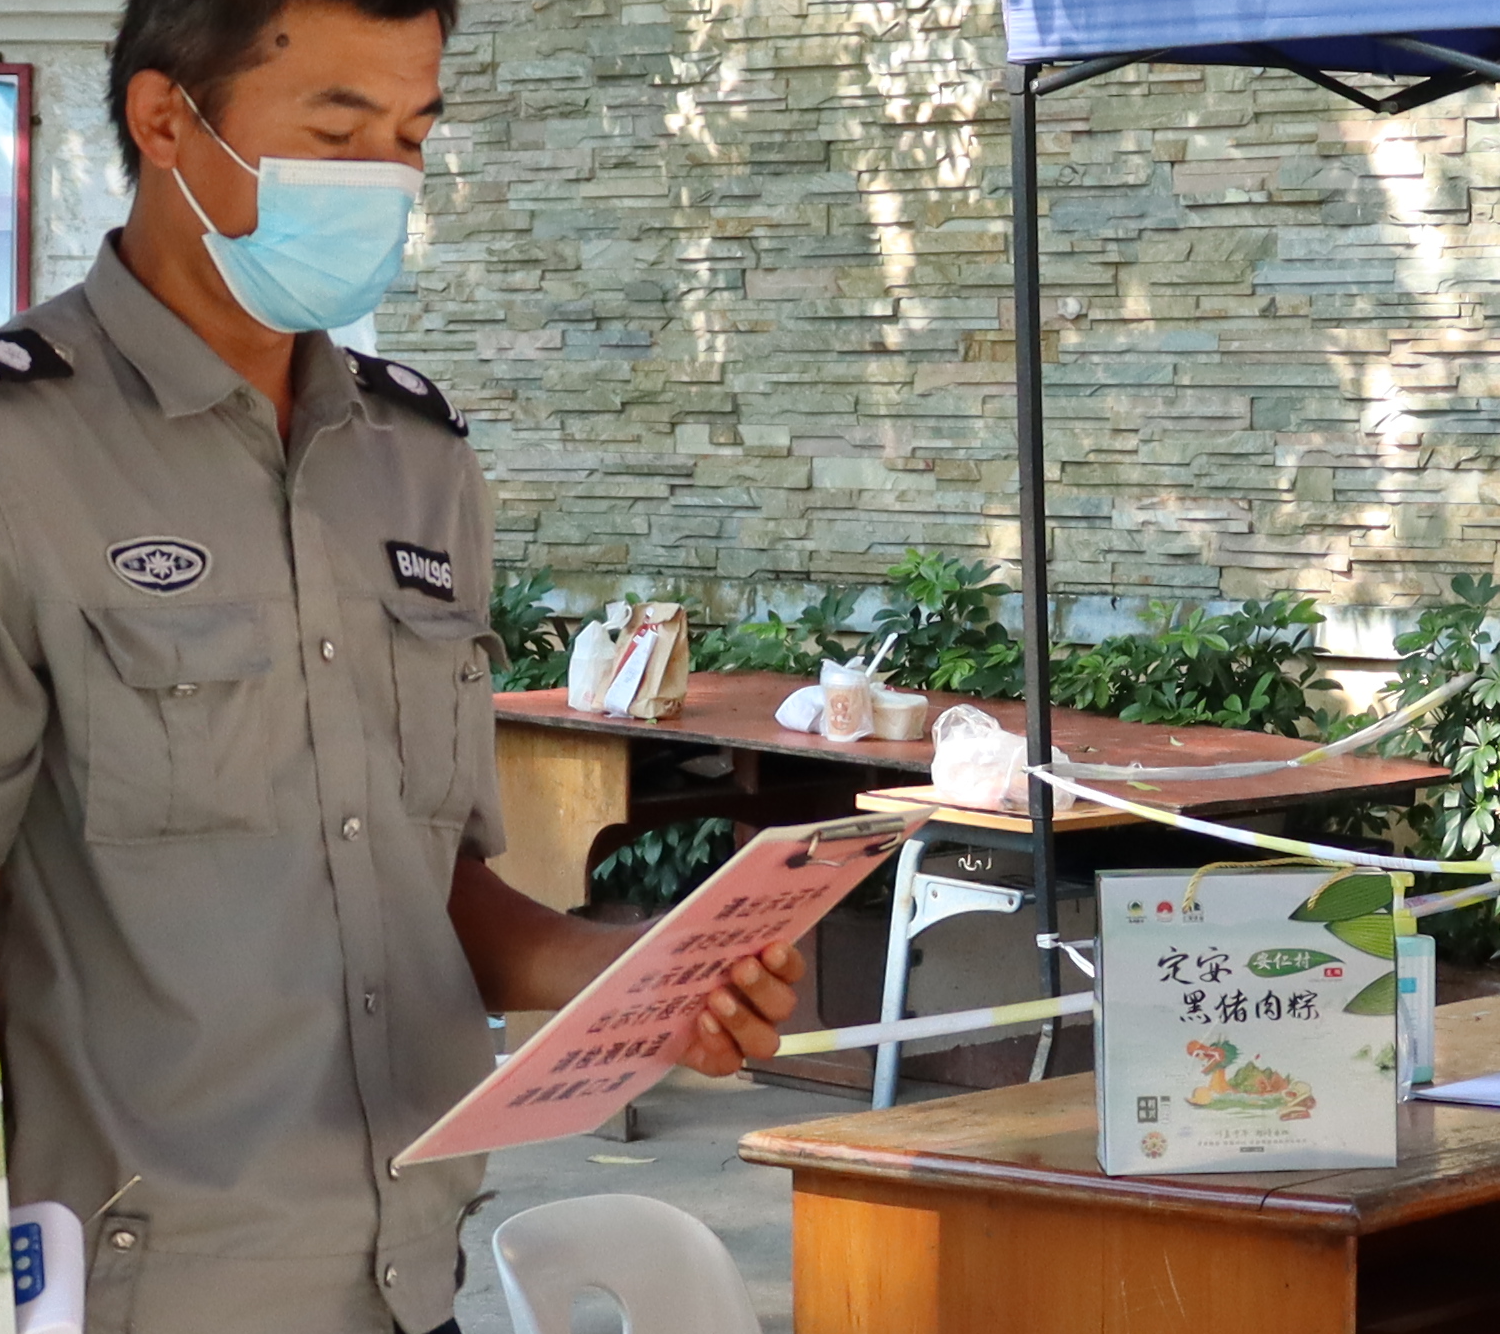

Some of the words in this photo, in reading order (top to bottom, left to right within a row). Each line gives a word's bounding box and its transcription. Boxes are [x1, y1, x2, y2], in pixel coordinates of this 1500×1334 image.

[1157, 946, 1233, 985] 定安
[1252, 951, 1312, 970] 安仁村
[1179, 988, 1320, 1025] 黑猪肉粽
